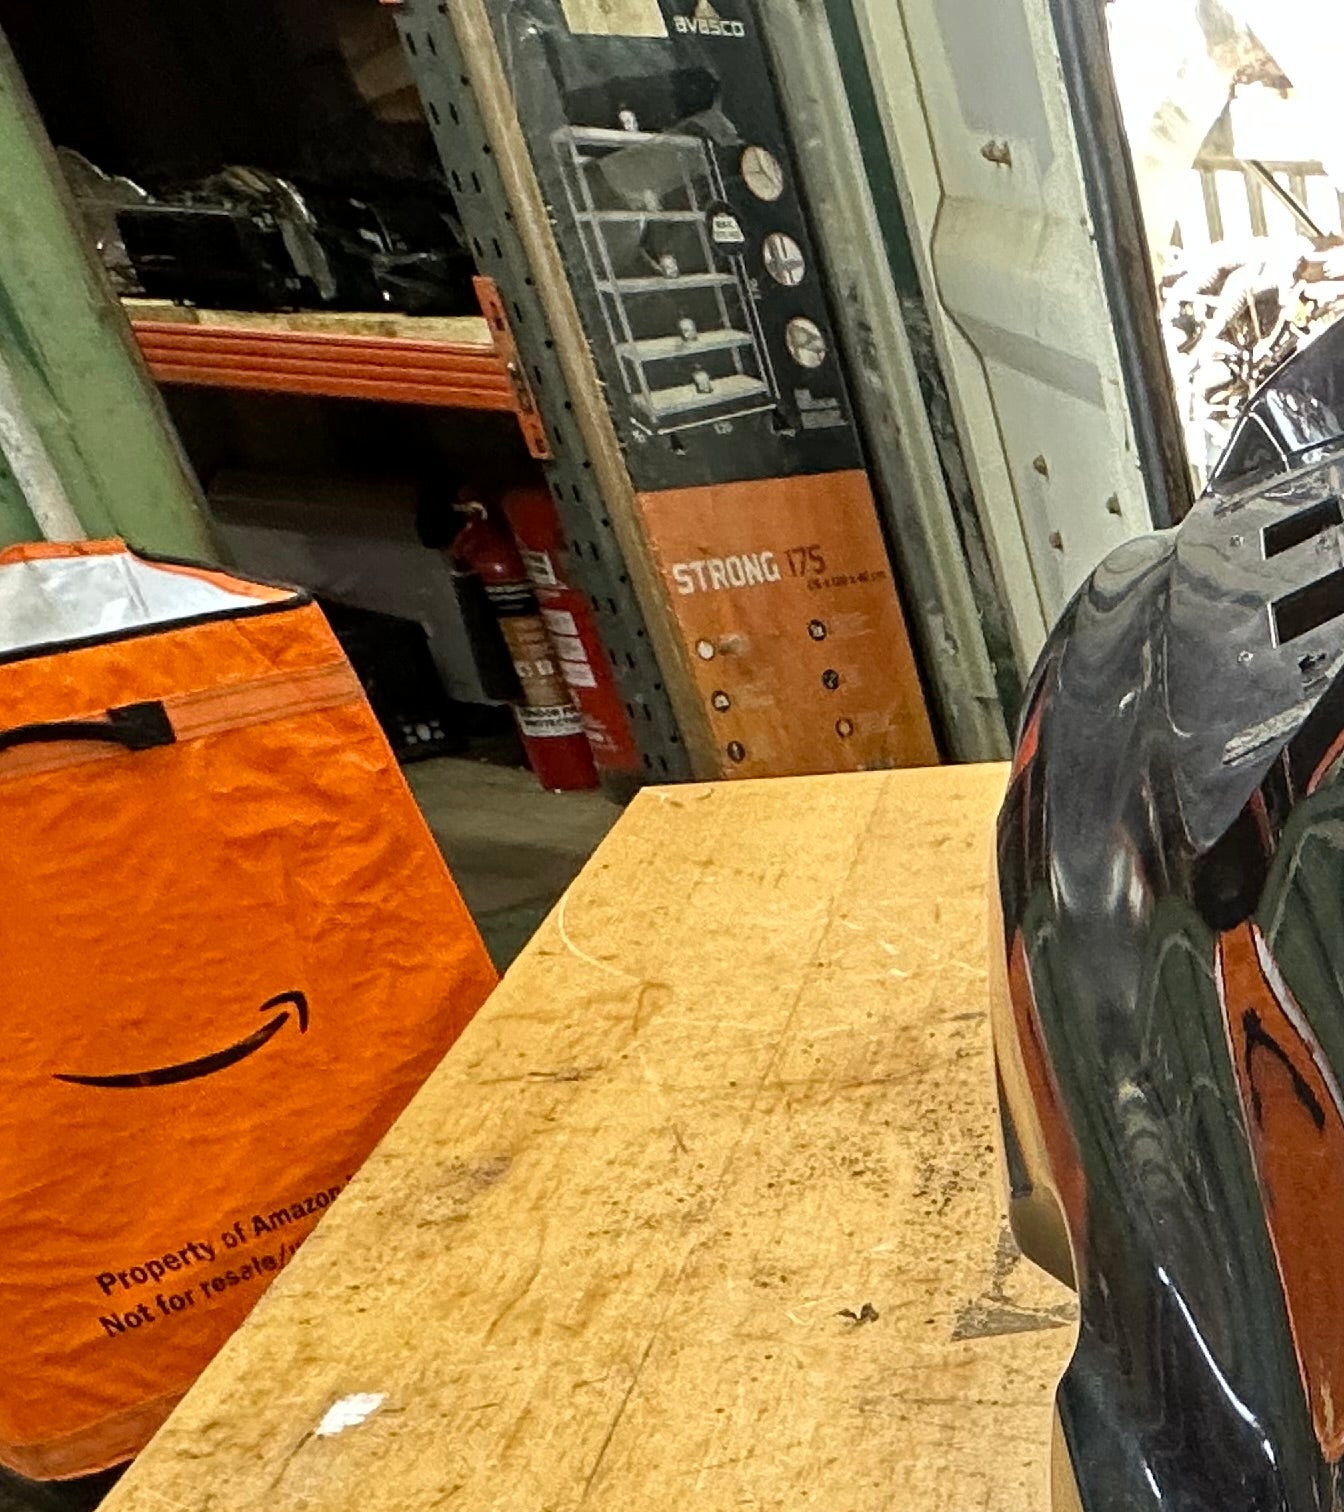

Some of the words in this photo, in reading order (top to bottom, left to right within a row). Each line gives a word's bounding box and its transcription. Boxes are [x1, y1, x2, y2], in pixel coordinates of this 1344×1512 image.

[672, 551, 781, 596] STRONG
[785, 545, 826, 578] 175
[95, 1240, 217, 1296] Property
[220, 1222, 248, 1249] of
[252, 1184, 342, 1236] Amazon
[99, 1303, 155, 1337] Not
[156, 1289, 195, 1315] for
